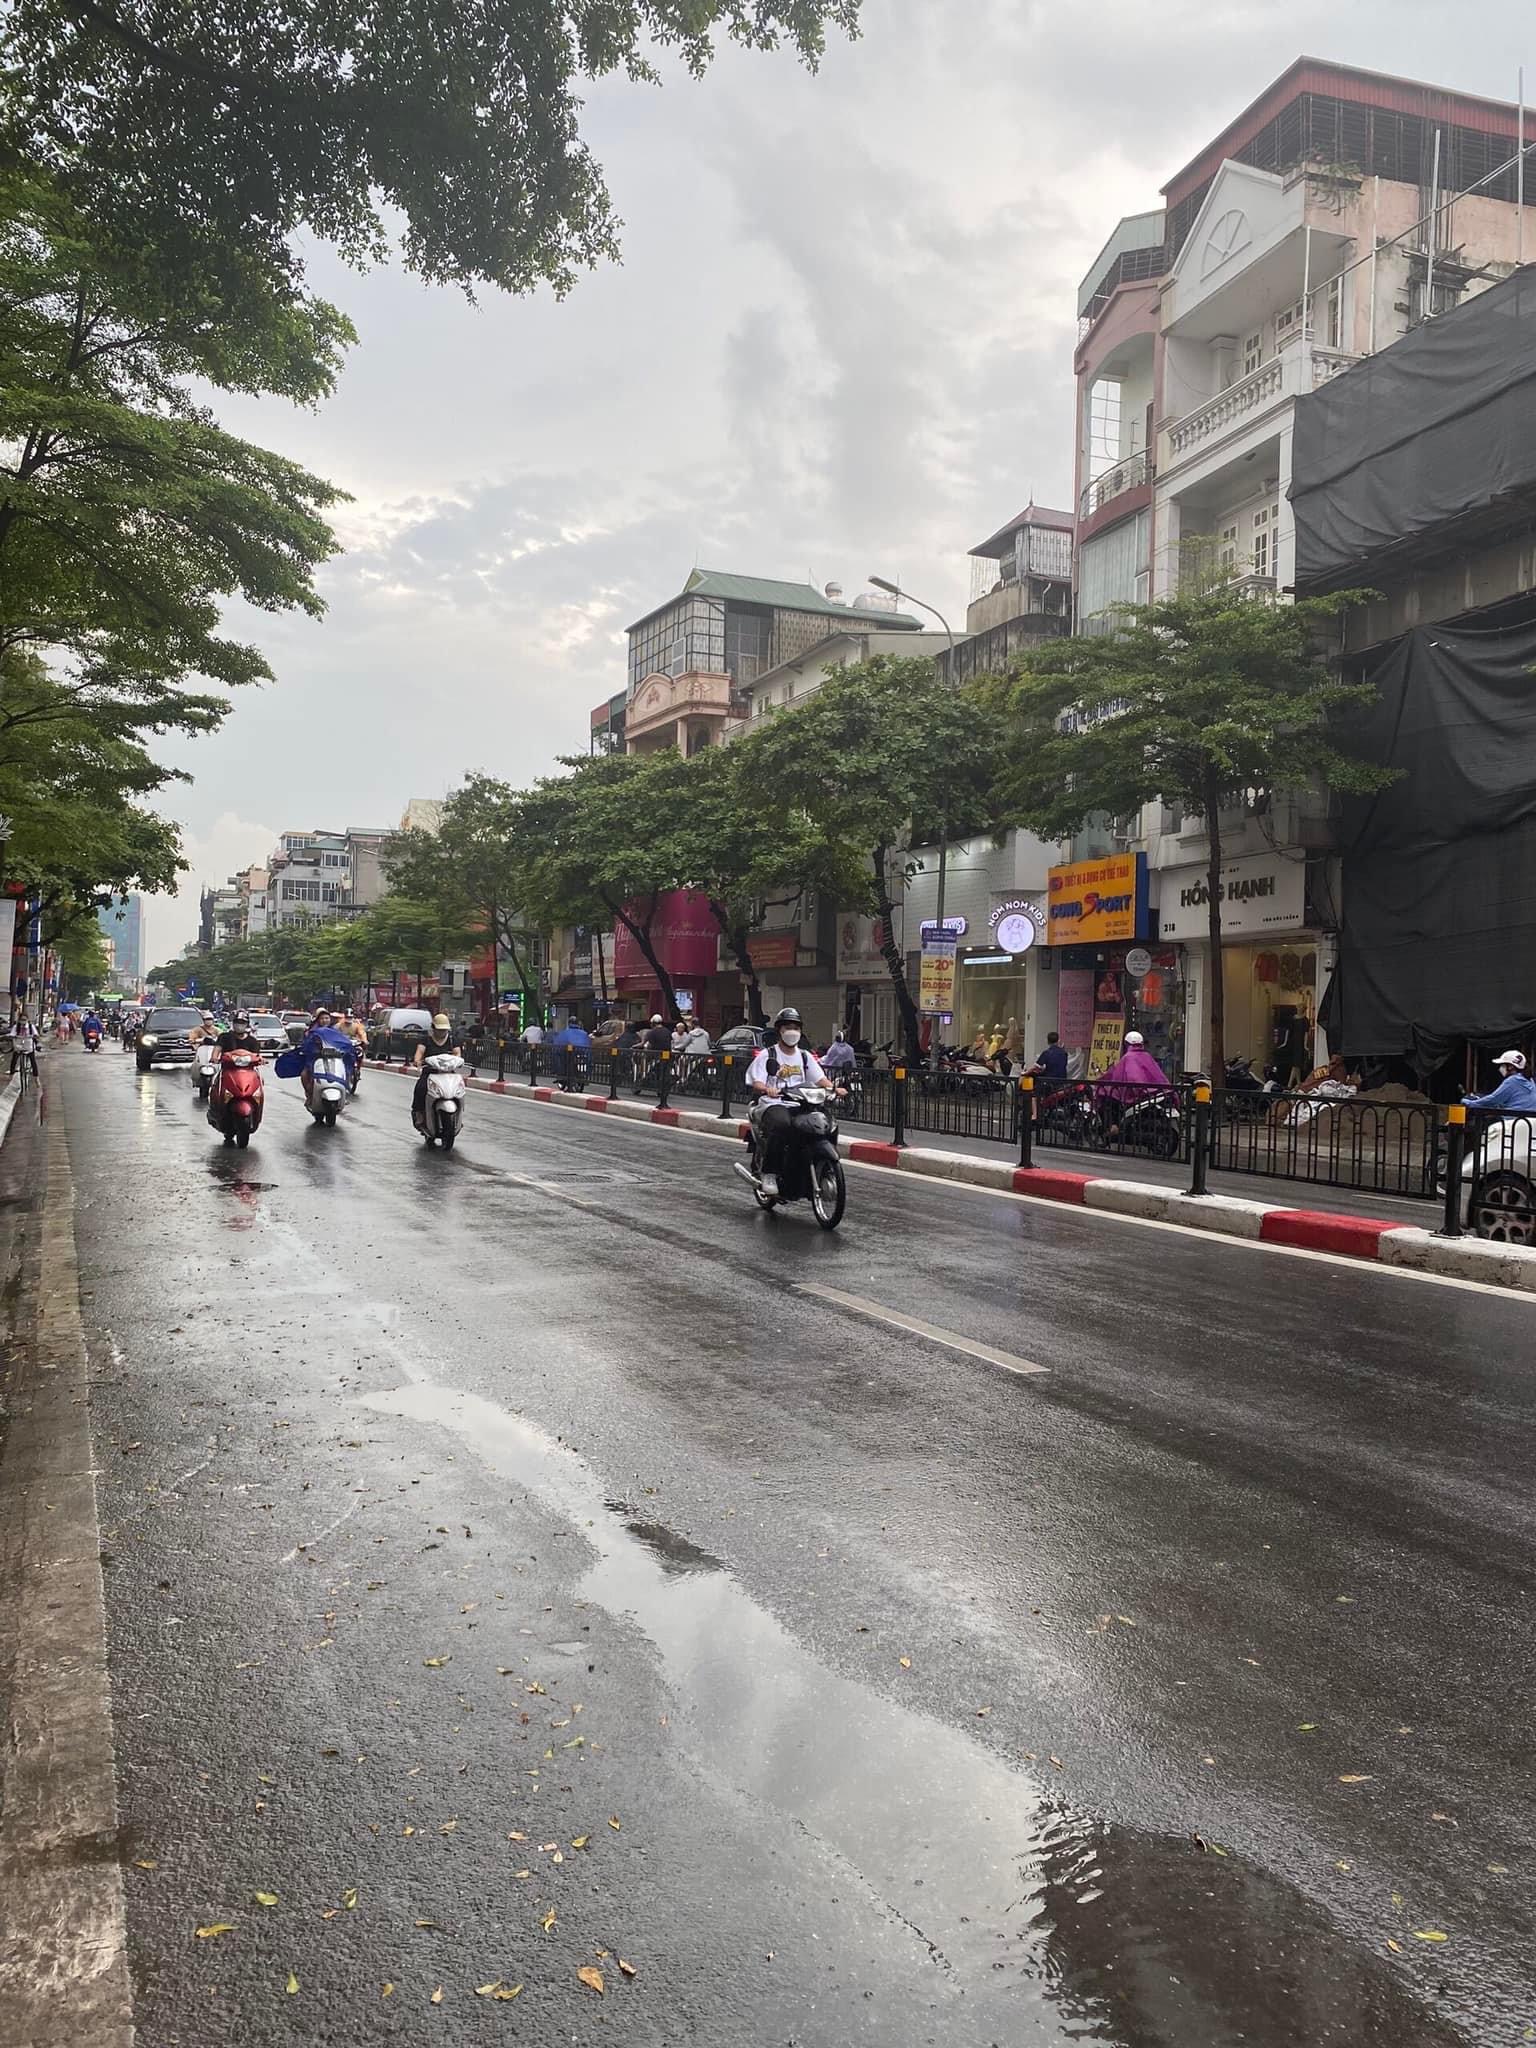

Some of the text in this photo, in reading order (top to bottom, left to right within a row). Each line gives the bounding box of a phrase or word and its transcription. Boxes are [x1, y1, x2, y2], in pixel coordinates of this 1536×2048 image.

[1228, 876, 1275, 904] HẠNH
[988, 906, 1005, 927] NOM
[1006, 900, 1029, 910] NOM
[1029, 905, 1047, 927] KIDS
[1105, 1039, 1120, 1050] THAO
